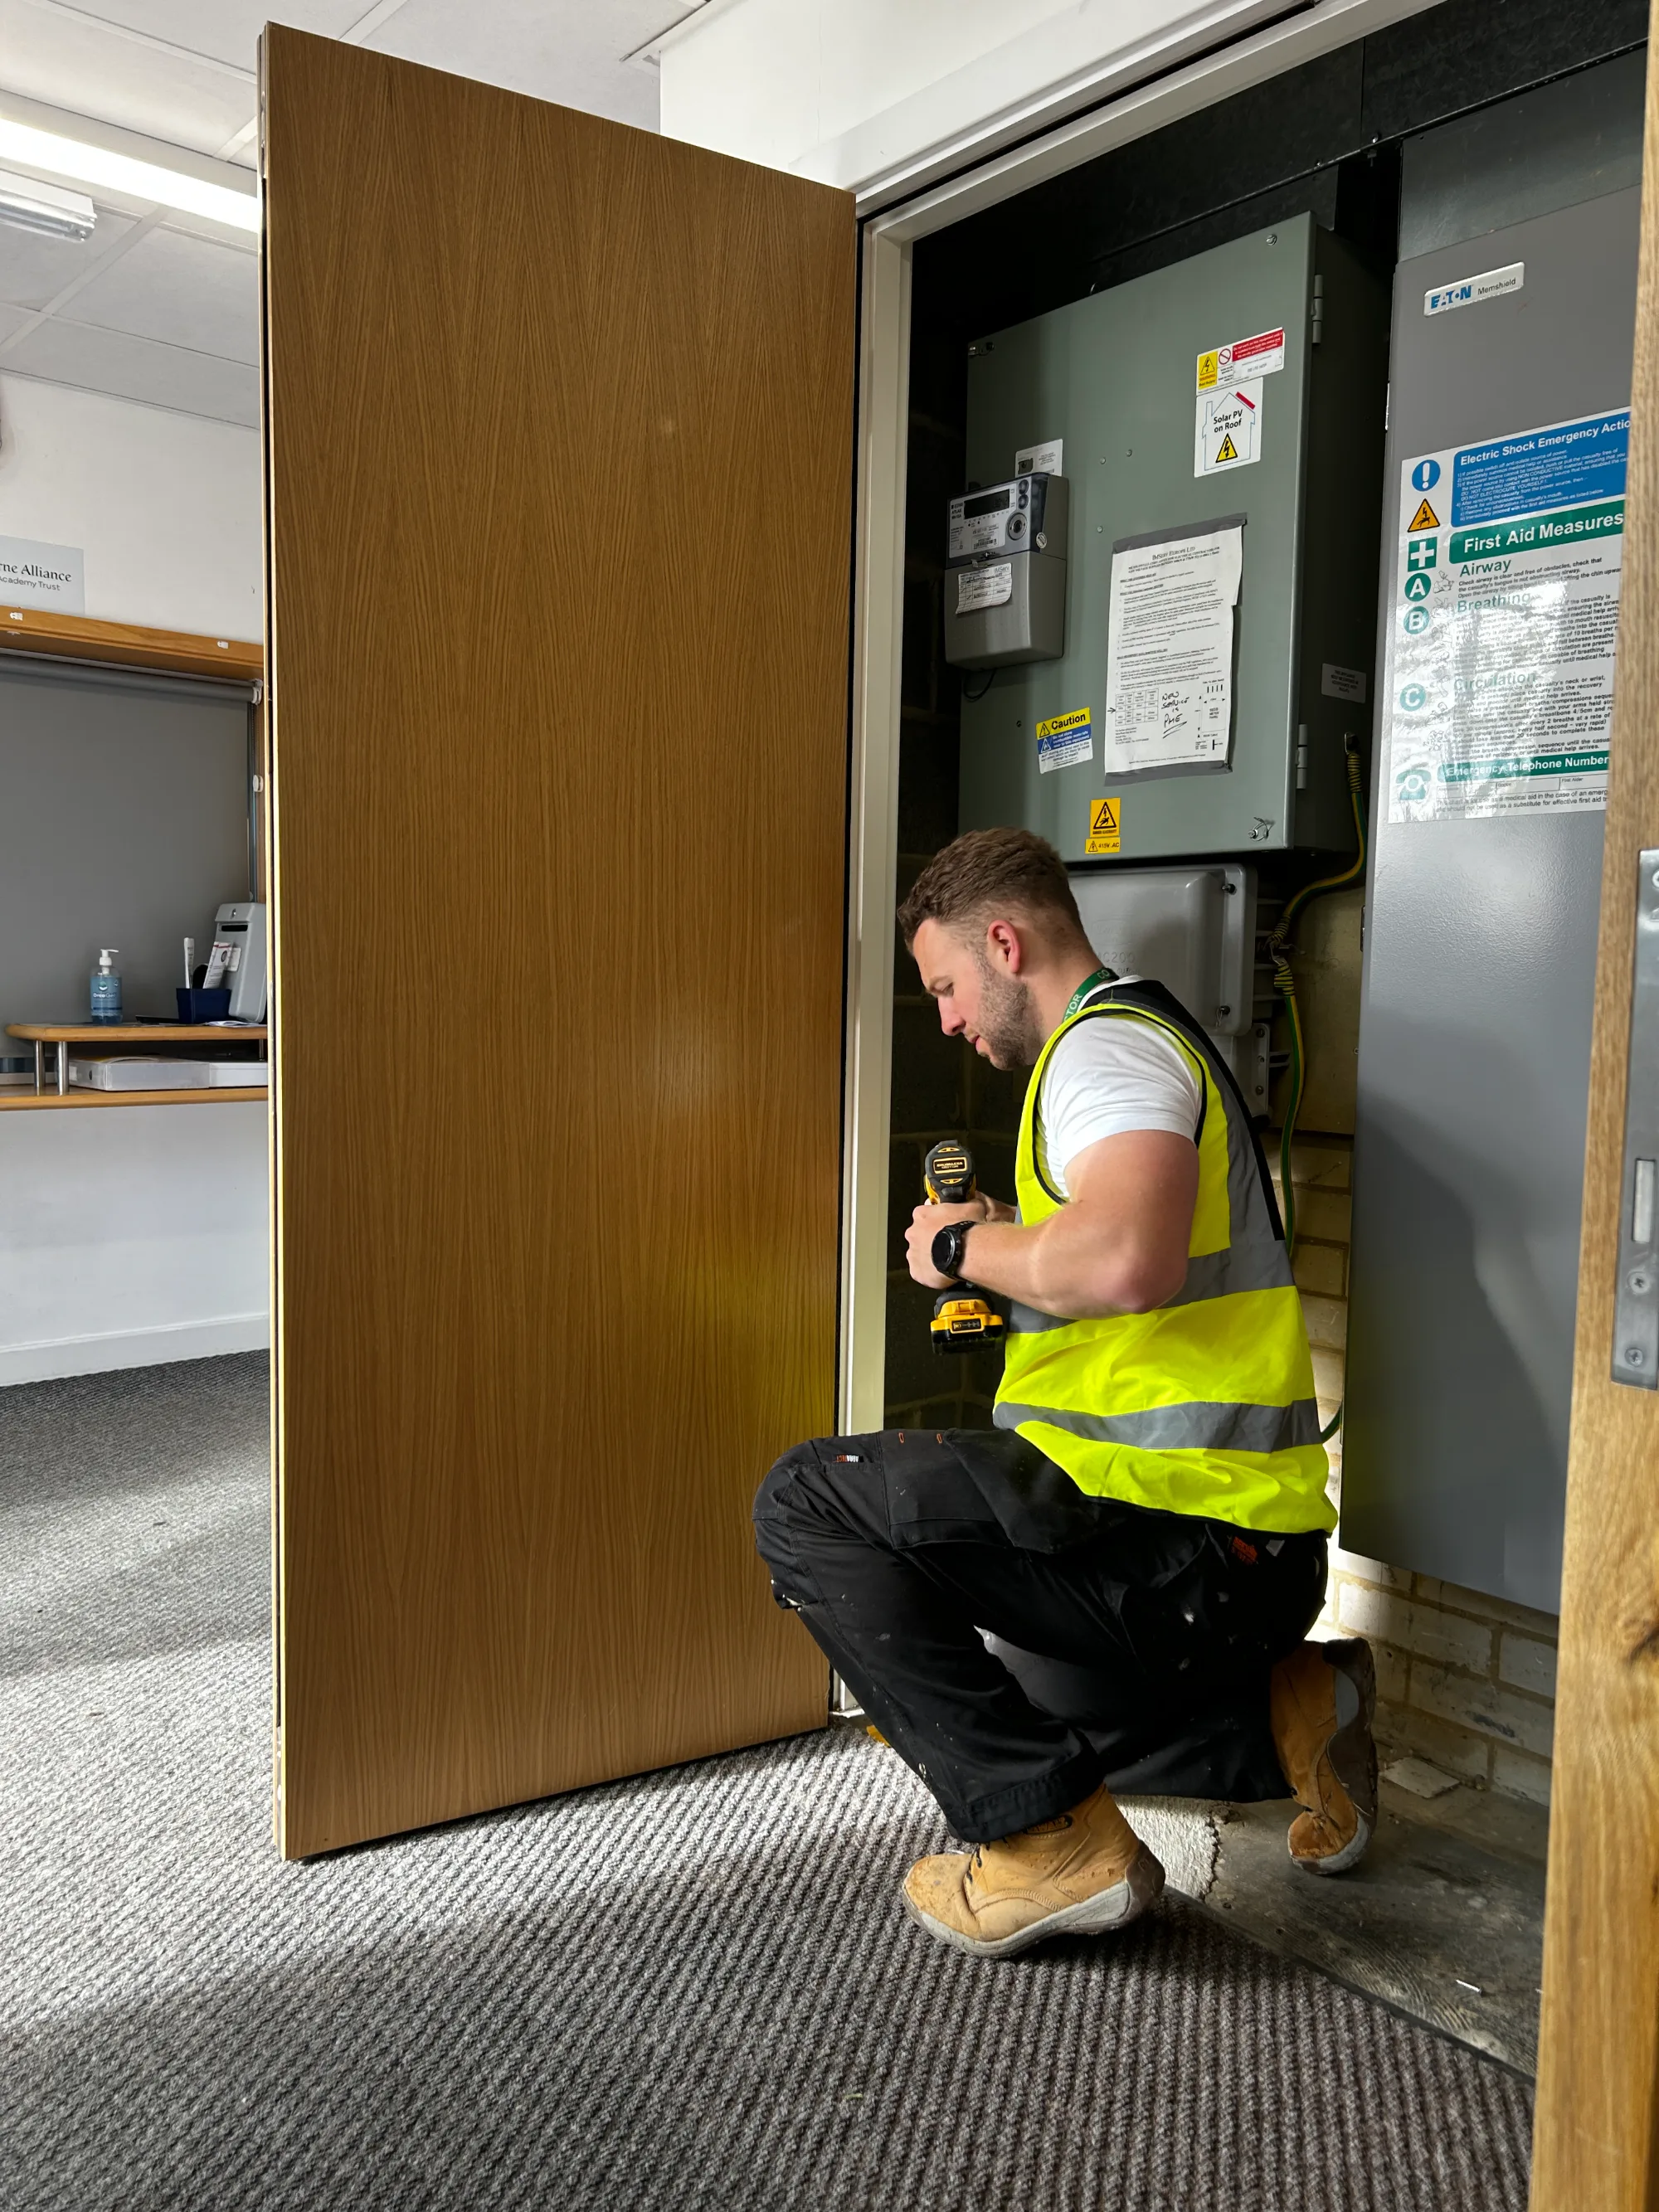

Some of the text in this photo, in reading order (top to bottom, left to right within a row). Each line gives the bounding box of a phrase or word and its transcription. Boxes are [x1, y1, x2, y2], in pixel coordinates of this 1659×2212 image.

[1430, 277, 1516, 309] EATON Memshield
[1214, 410, 1243, 425] Solar PV
[1214, 420, 1243, 433] on Roof
[1460, 449, 1499, 465] Electric
[1502, 440, 1535, 455] Shock
[1538, 426, 1598, 448] Emergency
[1464, 512, 1623, 553] First Aid Measures
[21, 564, 71, 582] Alliance
[1459, 559, 1511, 577] Airway
[38, 581, 61, 591] Trust
[1408, 576, 1426, 597] A
[1457, 591, 1530, 612] Breathing
[1408, 610, 1423, 630] B
[1592, 638, 1613, 646] present
[1454, 671, 1535, 691] Circulation
[1161, 692, 1180, 701] NEW
[1405, 687, 1420, 707] C
[1051, 713, 1085, 730] Caution
[1164, 713, 1183, 728] PME
[1447, 765, 1505, 775] Emergency
[1506, 760, 1561, 771] Telephone
